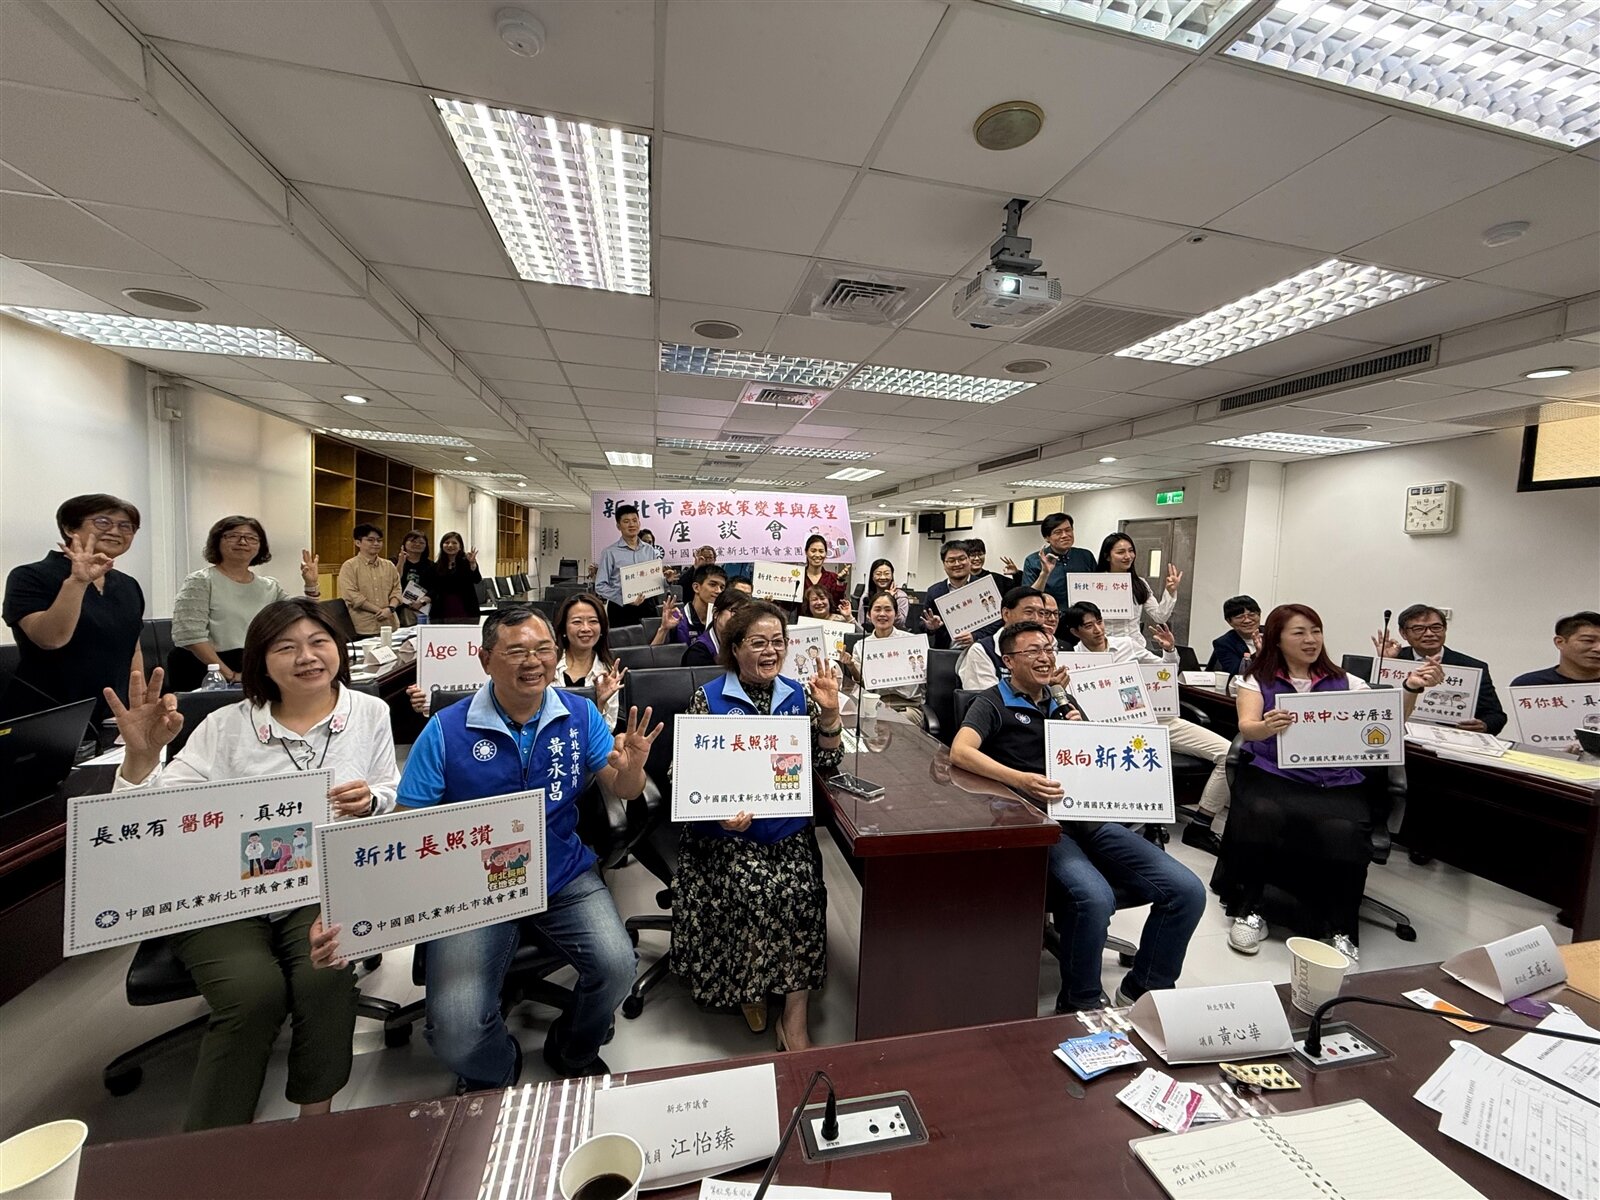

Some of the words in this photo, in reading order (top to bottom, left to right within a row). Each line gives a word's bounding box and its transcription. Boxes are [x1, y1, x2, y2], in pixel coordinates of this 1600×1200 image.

[680, 500, 838, 519] 高齡政策變革與展望
[669, 547, 803, 559] 中國黨新北市議會黨團
[425, 641, 457, 660] Age
[694, 733, 726, 751] 新北
[730, 733, 779, 752] 長照讚
[547, 737, 567, 801] 黃永昌
[569, 728, 581, 788] 新北市議員
[703, 792, 802, 803] 中國國民黨新北市議會黨團
[1076, 800, 1164, 811] 中國國民黨新北市議會黨團
[89, 818, 168, 848] 長照有
[178, 810, 224, 834] 醫師
[353, 841, 407, 868] 新北
[415, 824, 494, 860] 長照讚
[125, 874, 309, 921] 中國國民黨新北市議會黨團
[376, 886, 529, 931] 中國國民黨新北市議會黨團
[1199, 1035, 1214, 1046] 議員
[1217, 1022, 1261, 1046] 黃心華
[667, 1098, 709, 1114] 新北市議會
[671, 1125, 735, 1159] 江怡臻
